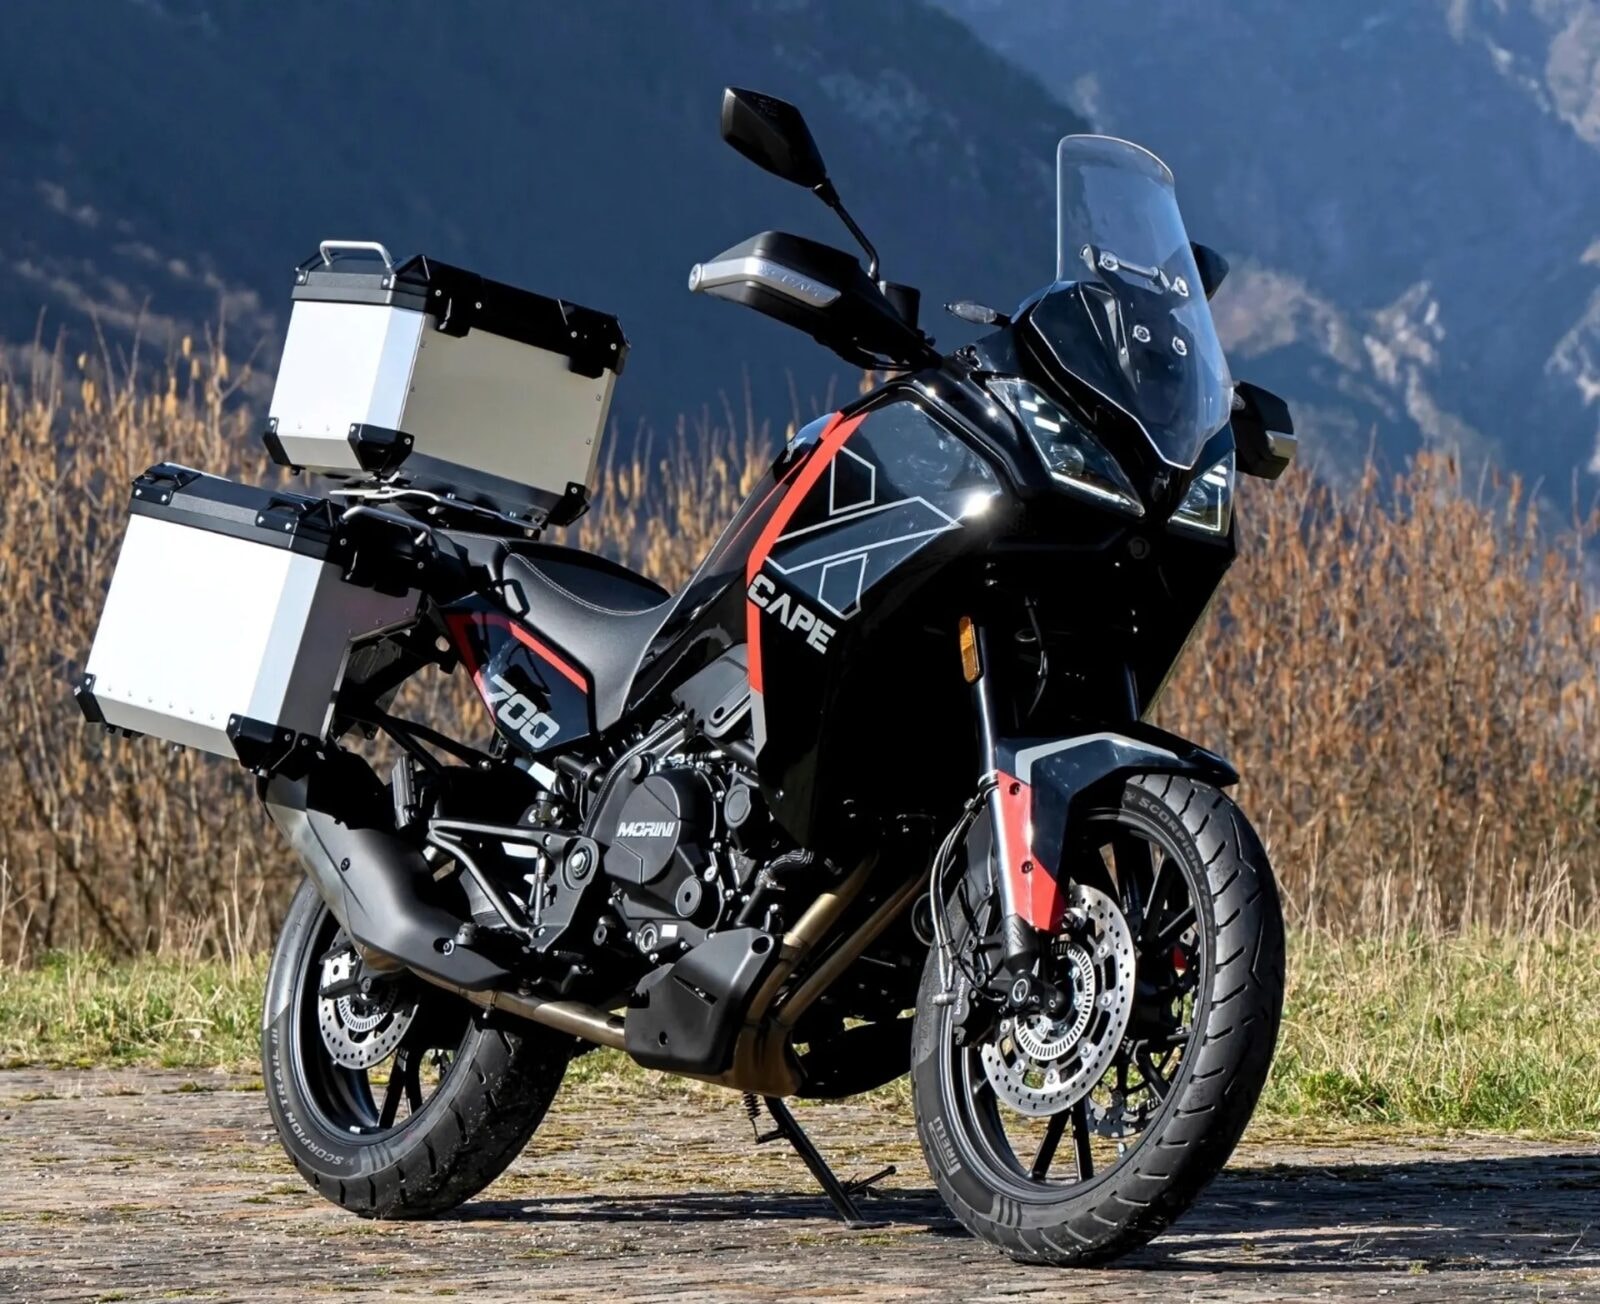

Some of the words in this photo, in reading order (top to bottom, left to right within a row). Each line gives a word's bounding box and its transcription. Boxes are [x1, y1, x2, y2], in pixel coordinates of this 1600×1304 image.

[747, 573, 837, 655] CAPE
[486, 673, 560, 748] 700
[616, 821, 676, 837] MORINI
[1138, 797, 1201, 875] SCORPION
[954, 977, 965, 1015] brembo
[271, 1049, 288, 1109] TRAIL
[285, 1111, 344, 1166] SCORPION
[928, 1116, 962, 1177] PIRELLI
